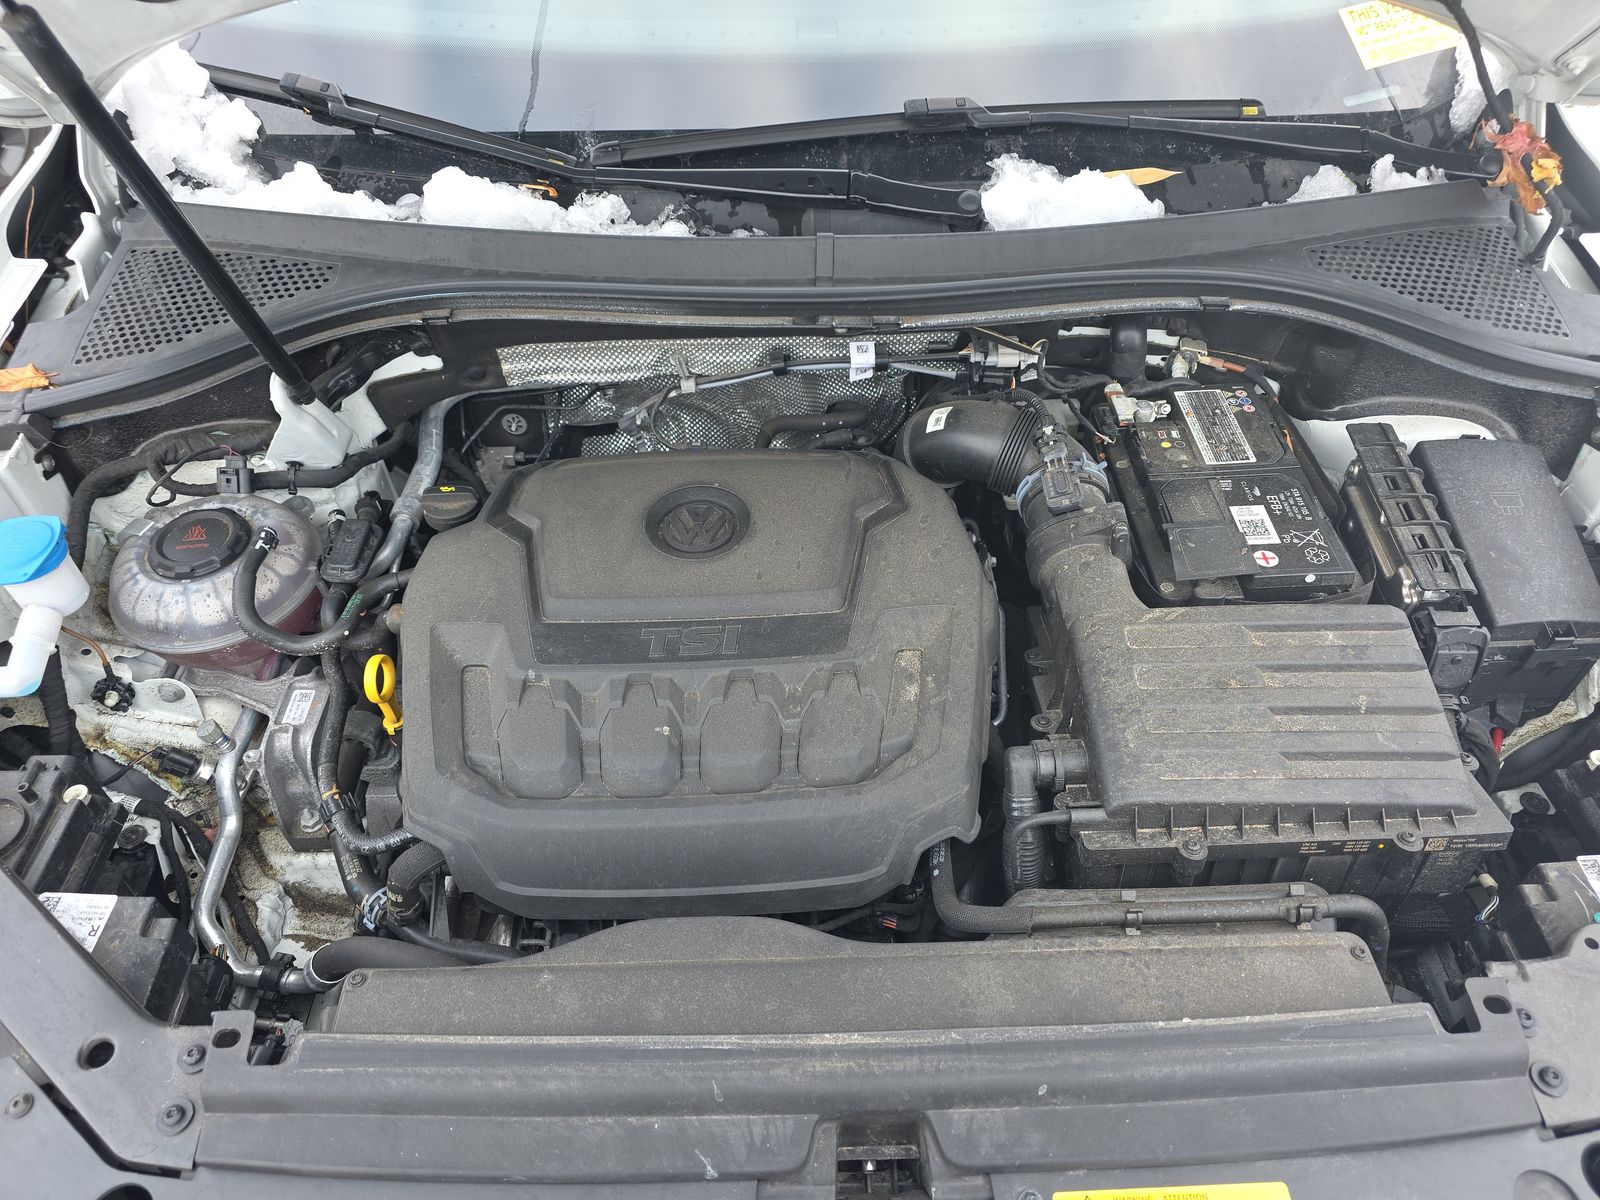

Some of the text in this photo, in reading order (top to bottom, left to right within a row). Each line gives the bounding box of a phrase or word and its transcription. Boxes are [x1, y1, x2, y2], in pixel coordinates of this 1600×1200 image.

[1346, 5, 1380, 23] THIS
[1266, 495, 1283, 515] EFB+
[1281, 534, 1292, 544] Pb
[640, 624, 742, 658] TSI
[88, 924, 101, 937] R
